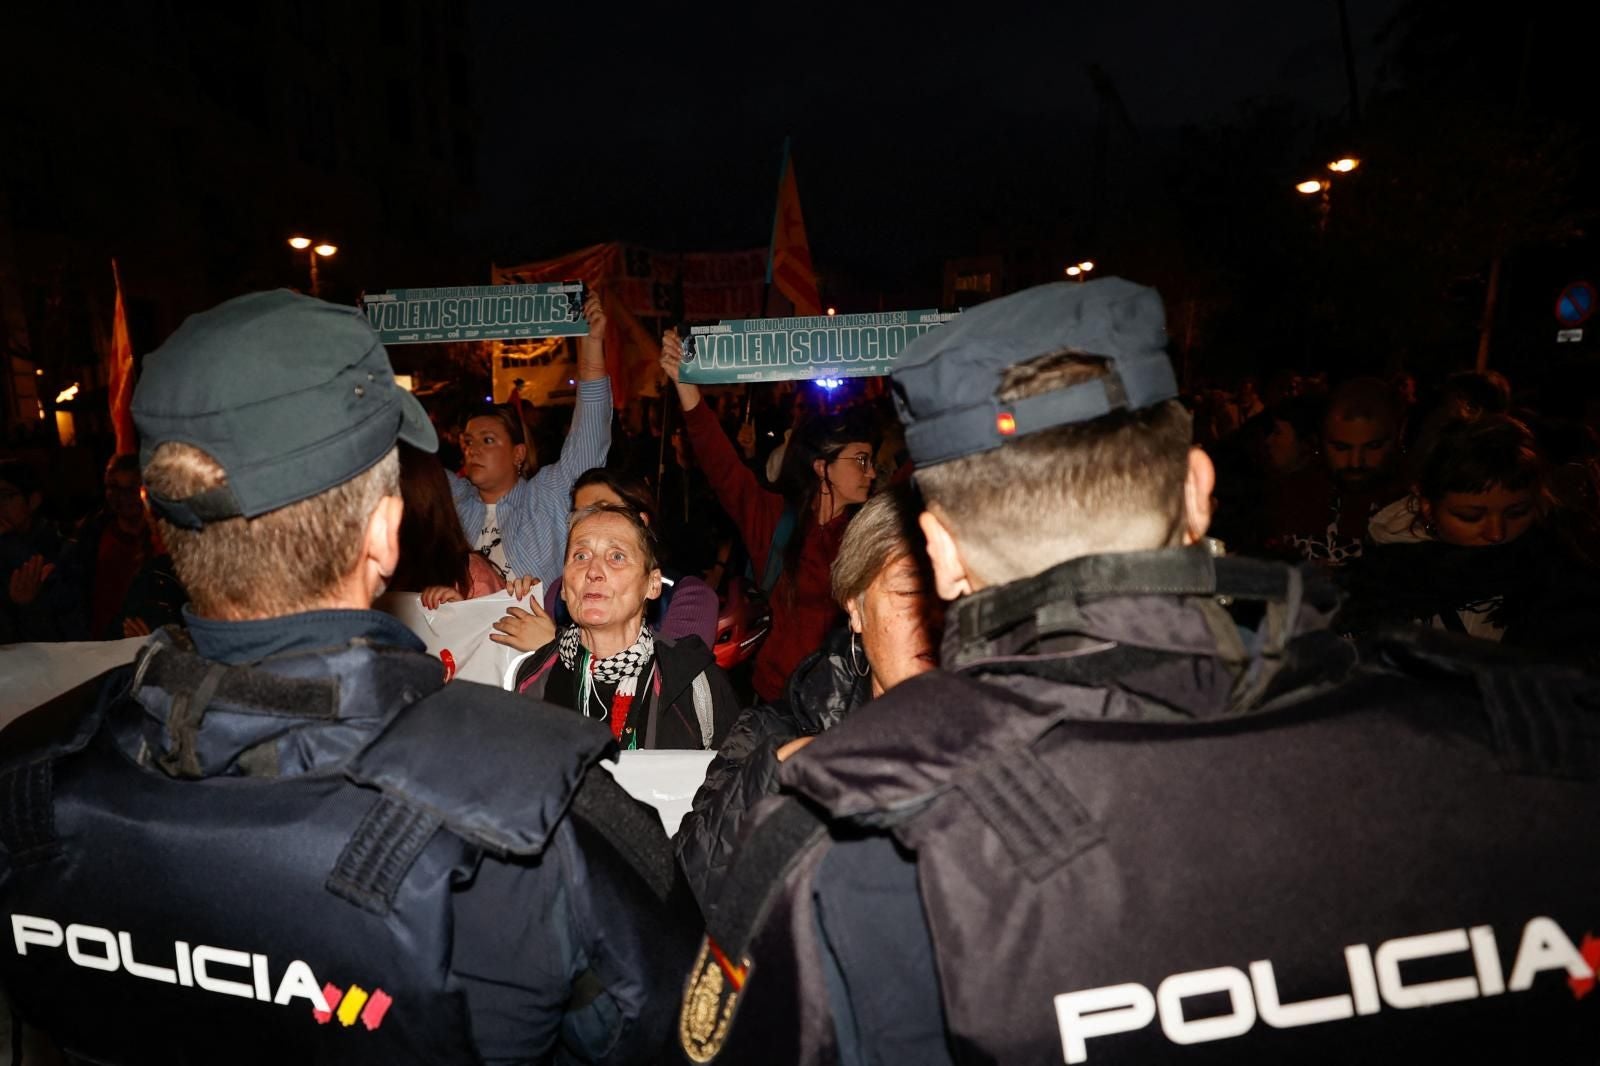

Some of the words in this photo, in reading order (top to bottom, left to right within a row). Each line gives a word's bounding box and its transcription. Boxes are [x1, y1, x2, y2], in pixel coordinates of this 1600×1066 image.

[367, 299, 441, 332] VOLEM
[819, 314, 845, 329] AMB
[695, 331, 789, 370] VOLEM
[11, 914, 331, 1012] POLICIA
[1054, 916, 1593, 1065] POLICIA
